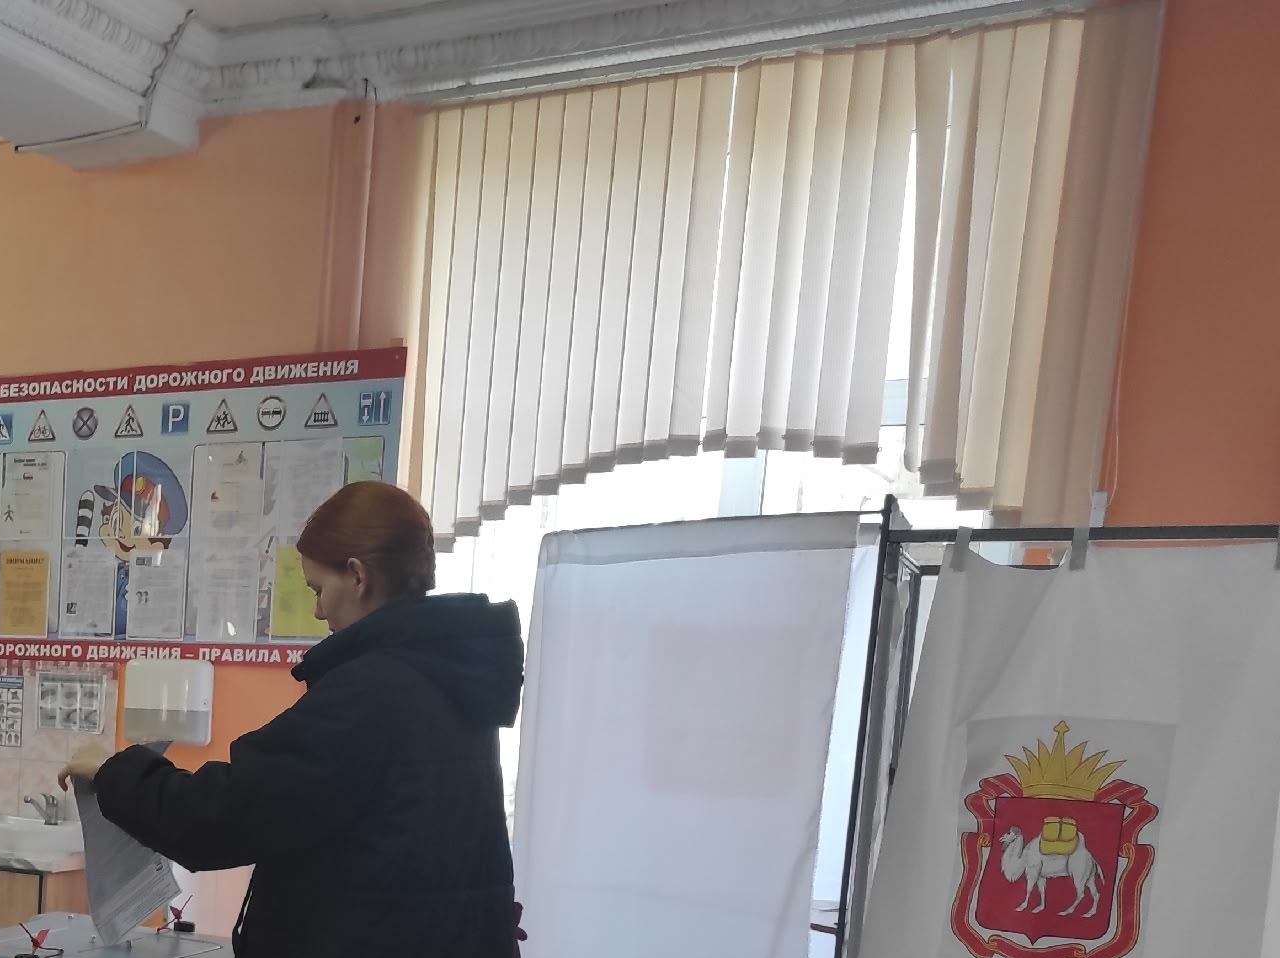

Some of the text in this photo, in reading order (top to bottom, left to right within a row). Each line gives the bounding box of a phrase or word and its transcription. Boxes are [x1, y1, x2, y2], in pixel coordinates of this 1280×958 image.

[0, 375, 129, 398] БЕЗОПАСНОСТИ
[133, 366, 245, 392] ДОРОЖНОГО
[249, 359, 359, 384] ДВИЖЕНИЯ
[86, 645, 181, 661] ДВИЖЕНИЯ
[198, 647, 282, 663] ПРАВИЛА
